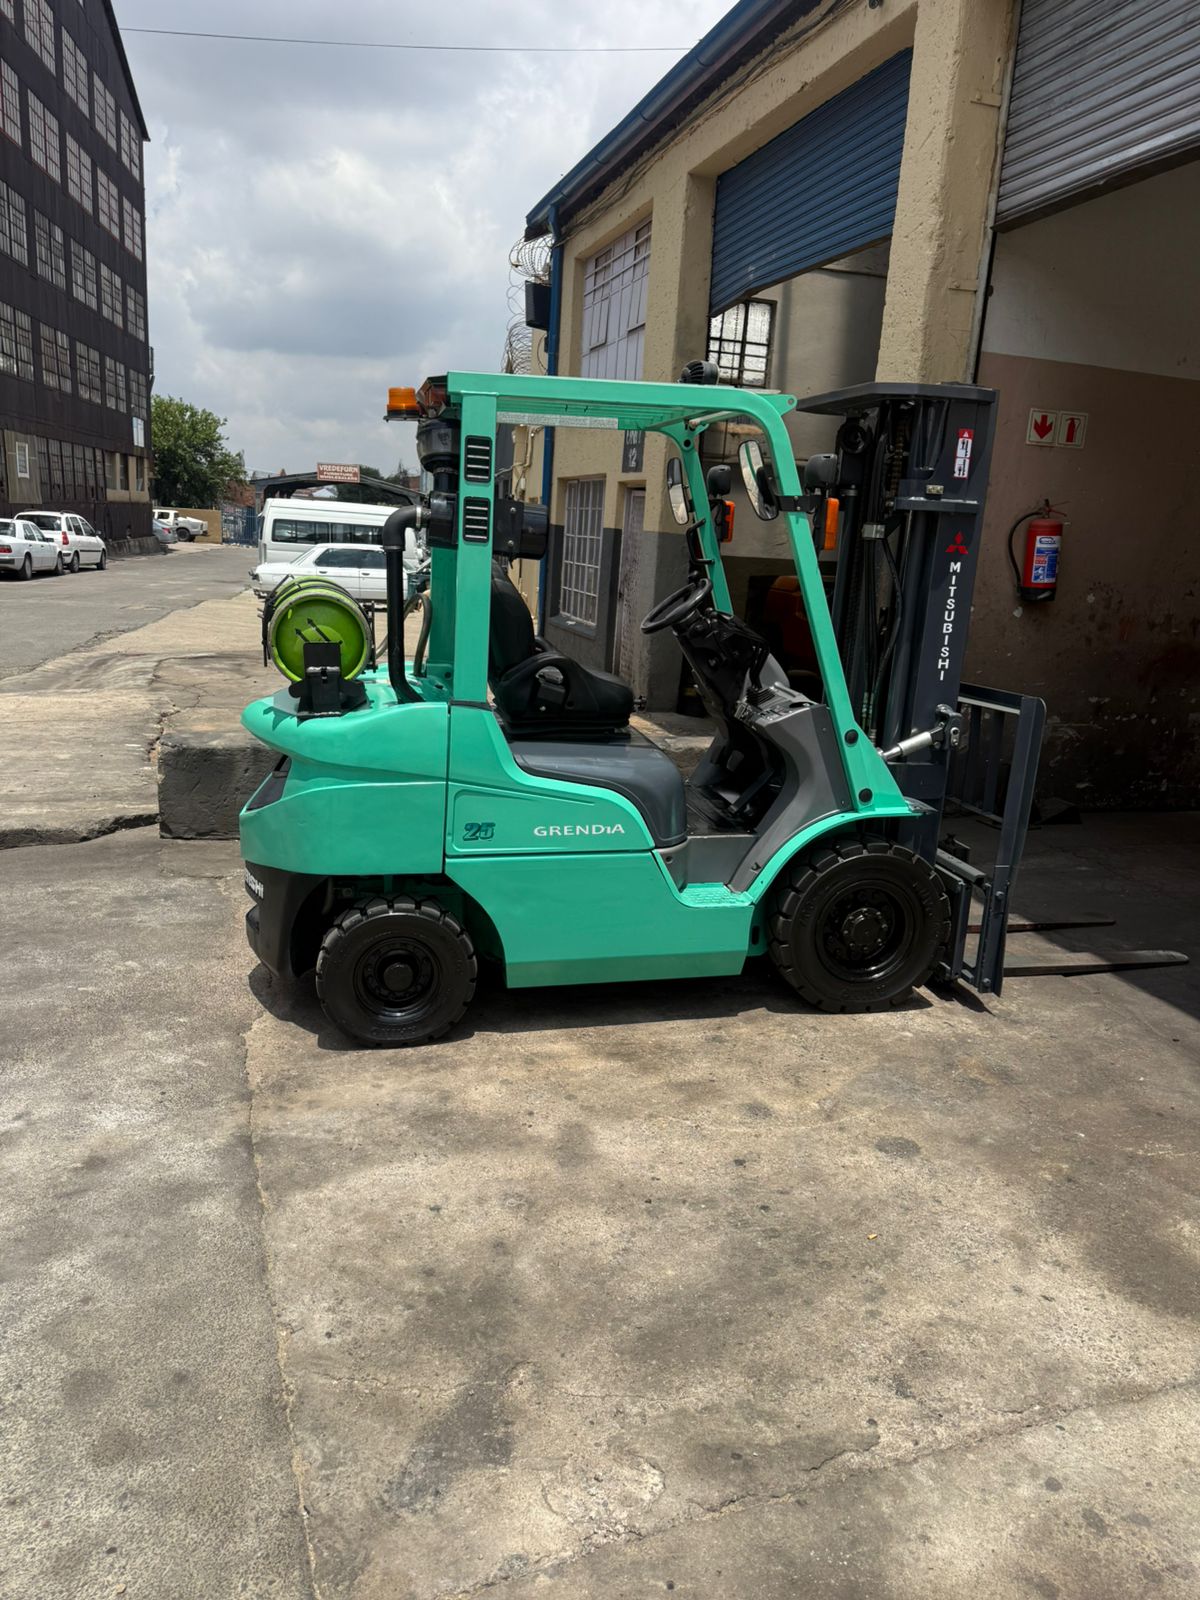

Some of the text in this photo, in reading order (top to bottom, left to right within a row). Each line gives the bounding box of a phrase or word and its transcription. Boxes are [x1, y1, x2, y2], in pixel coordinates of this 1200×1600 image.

[938, 561, 961, 681] MITSUBISHI
[463, 822, 495, 841] 25
[533, 823, 625, 837] GRENDIA
